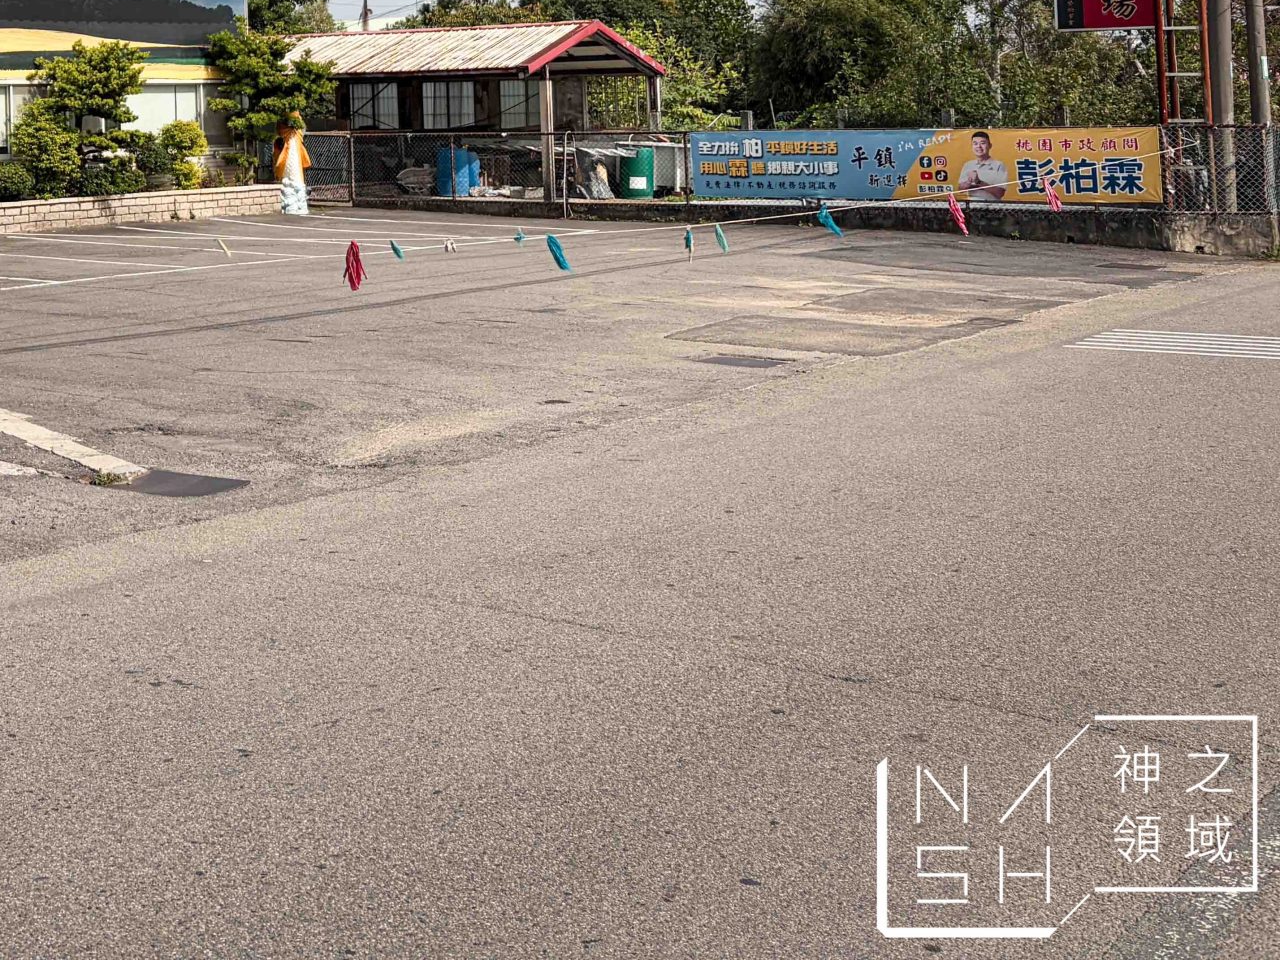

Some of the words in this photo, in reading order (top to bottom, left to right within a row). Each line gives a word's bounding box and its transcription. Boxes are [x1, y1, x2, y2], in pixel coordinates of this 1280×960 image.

[898, 141, 914, 153] I'M
[918, 133, 952, 149] READY
[1016, 137, 1140, 152] 桃園市政顧問
[850, 146, 897, 170] 平鎮
[868, 174, 908, 188] 新選擇
[1016, 157, 1146, 196] 彭柏霖
